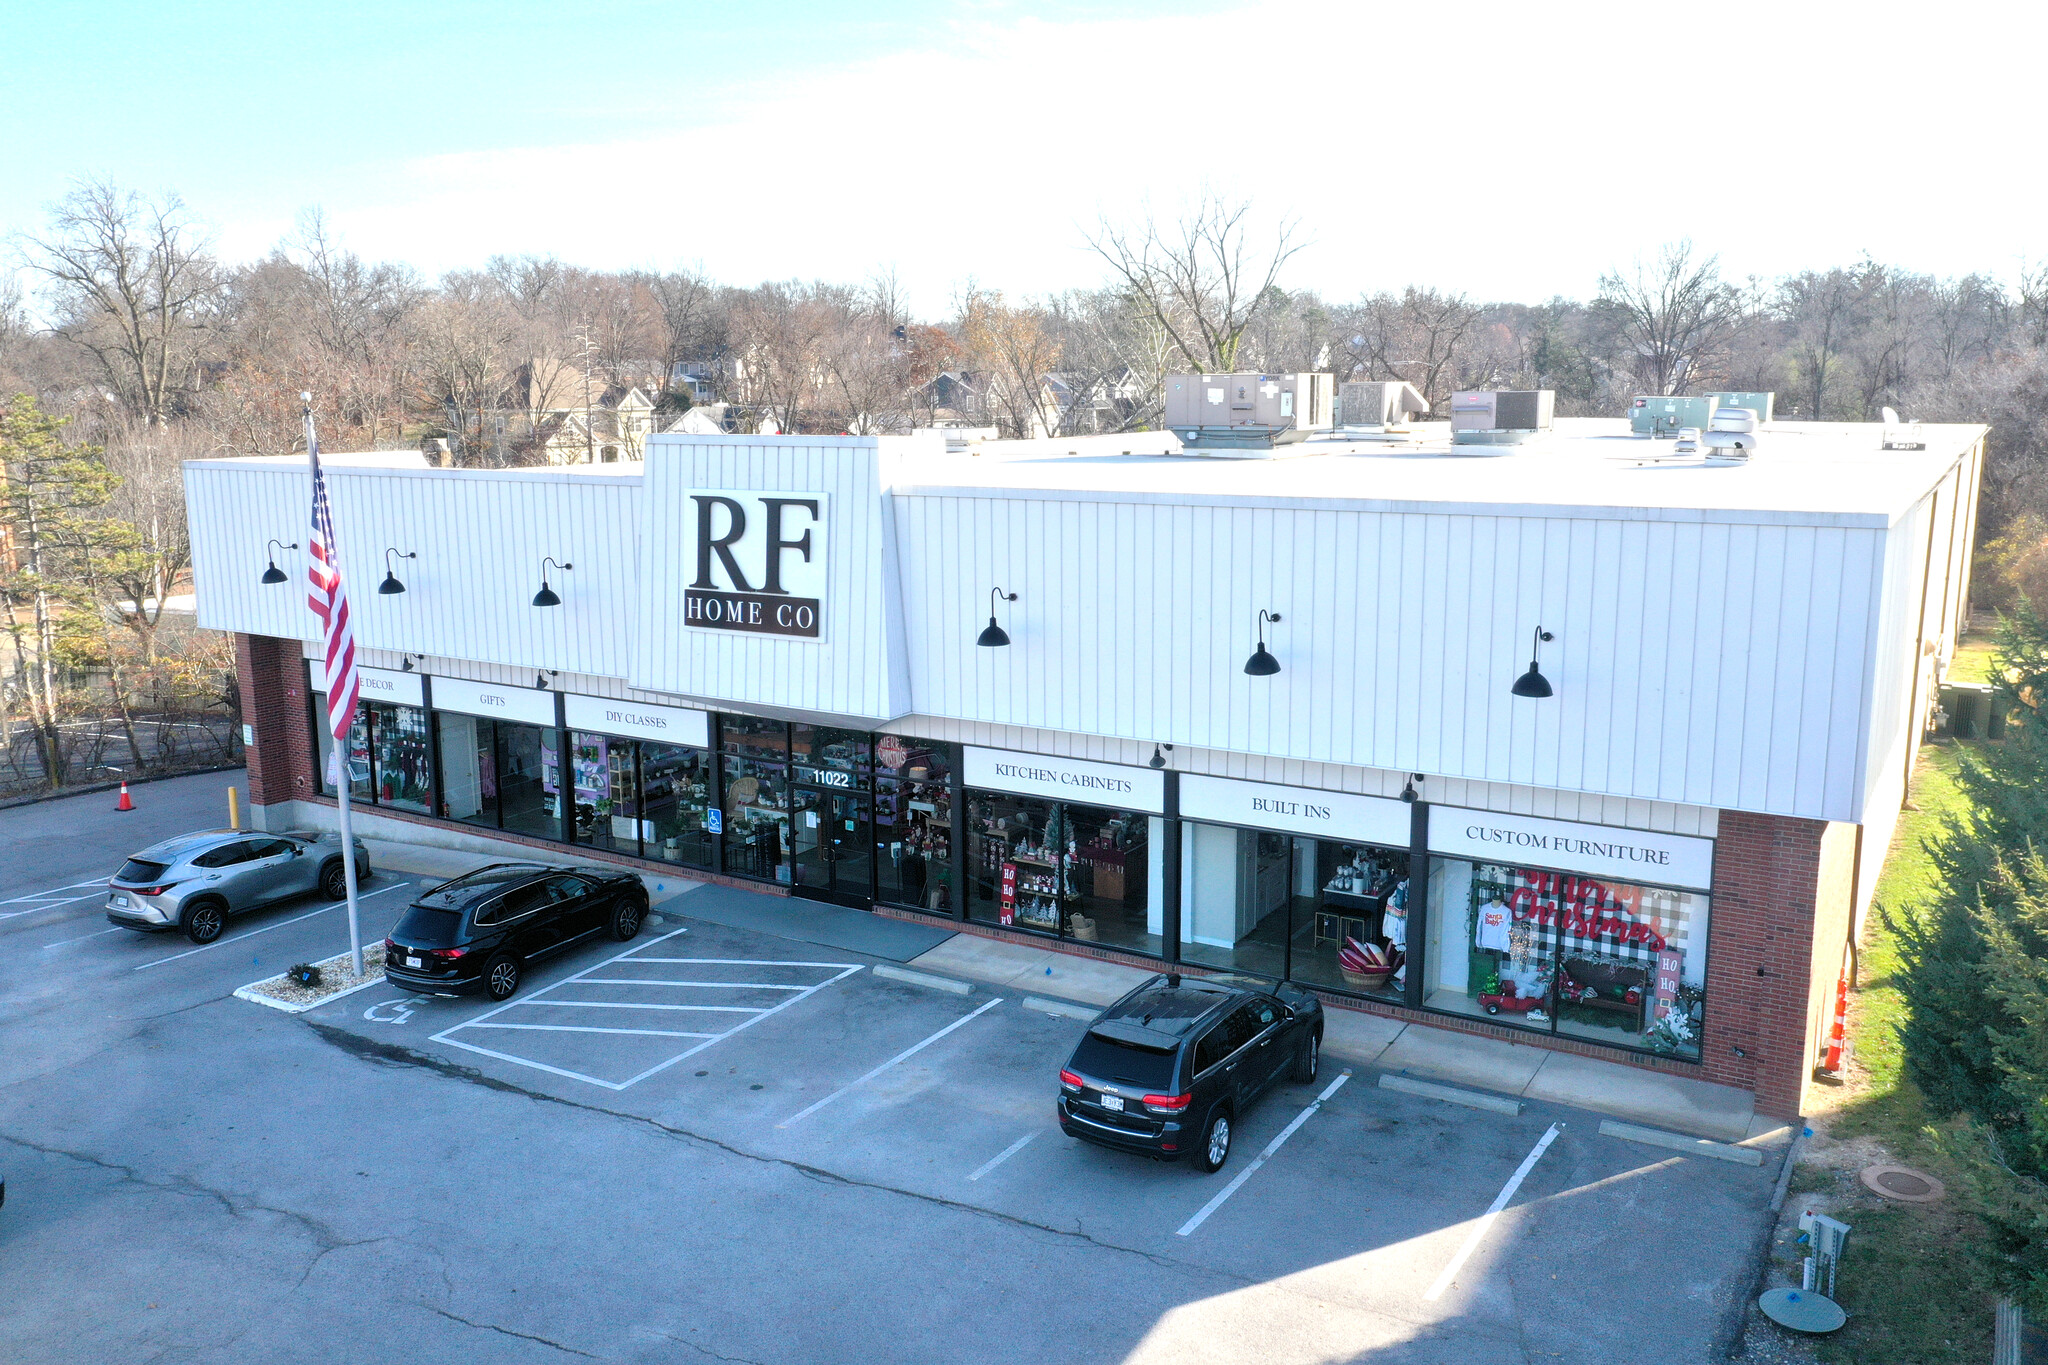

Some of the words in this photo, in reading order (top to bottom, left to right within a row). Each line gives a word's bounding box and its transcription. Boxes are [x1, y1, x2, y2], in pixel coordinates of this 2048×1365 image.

[689, 495, 818, 594] RF
[686, 597, 762, 625] HOME
[776, 604, 813, 629] CO
[366, 678, 394, 691] DECOR
[479, 693, 506, 708] GIFTS
[605, 710, 623, 725] DIY
[625, 712, 667, 729] CLASSES
[813, 769, 849, 788] 11022
[995, 763, 1058, 783] KITCHEN
[1060, 770, 1132, 793] CABINETS
[1252, 797, 1300, 816] BUILT
[1303, 803, 1331, 820] INS
[1465, 825, 1548, 850] CUSTOM
[1553, 837, 1670, 865] FURNITURE
[1004, 869, 1015, 880] HO
[1003, 884, 1014, 897] HO
[1510, 887, 1672, 952] Christmas
[1661, 957, 1678, 972] HO
[1660, 977, 1675, 993] HO
[1103, 1084, 1119, 1093] Jeep
